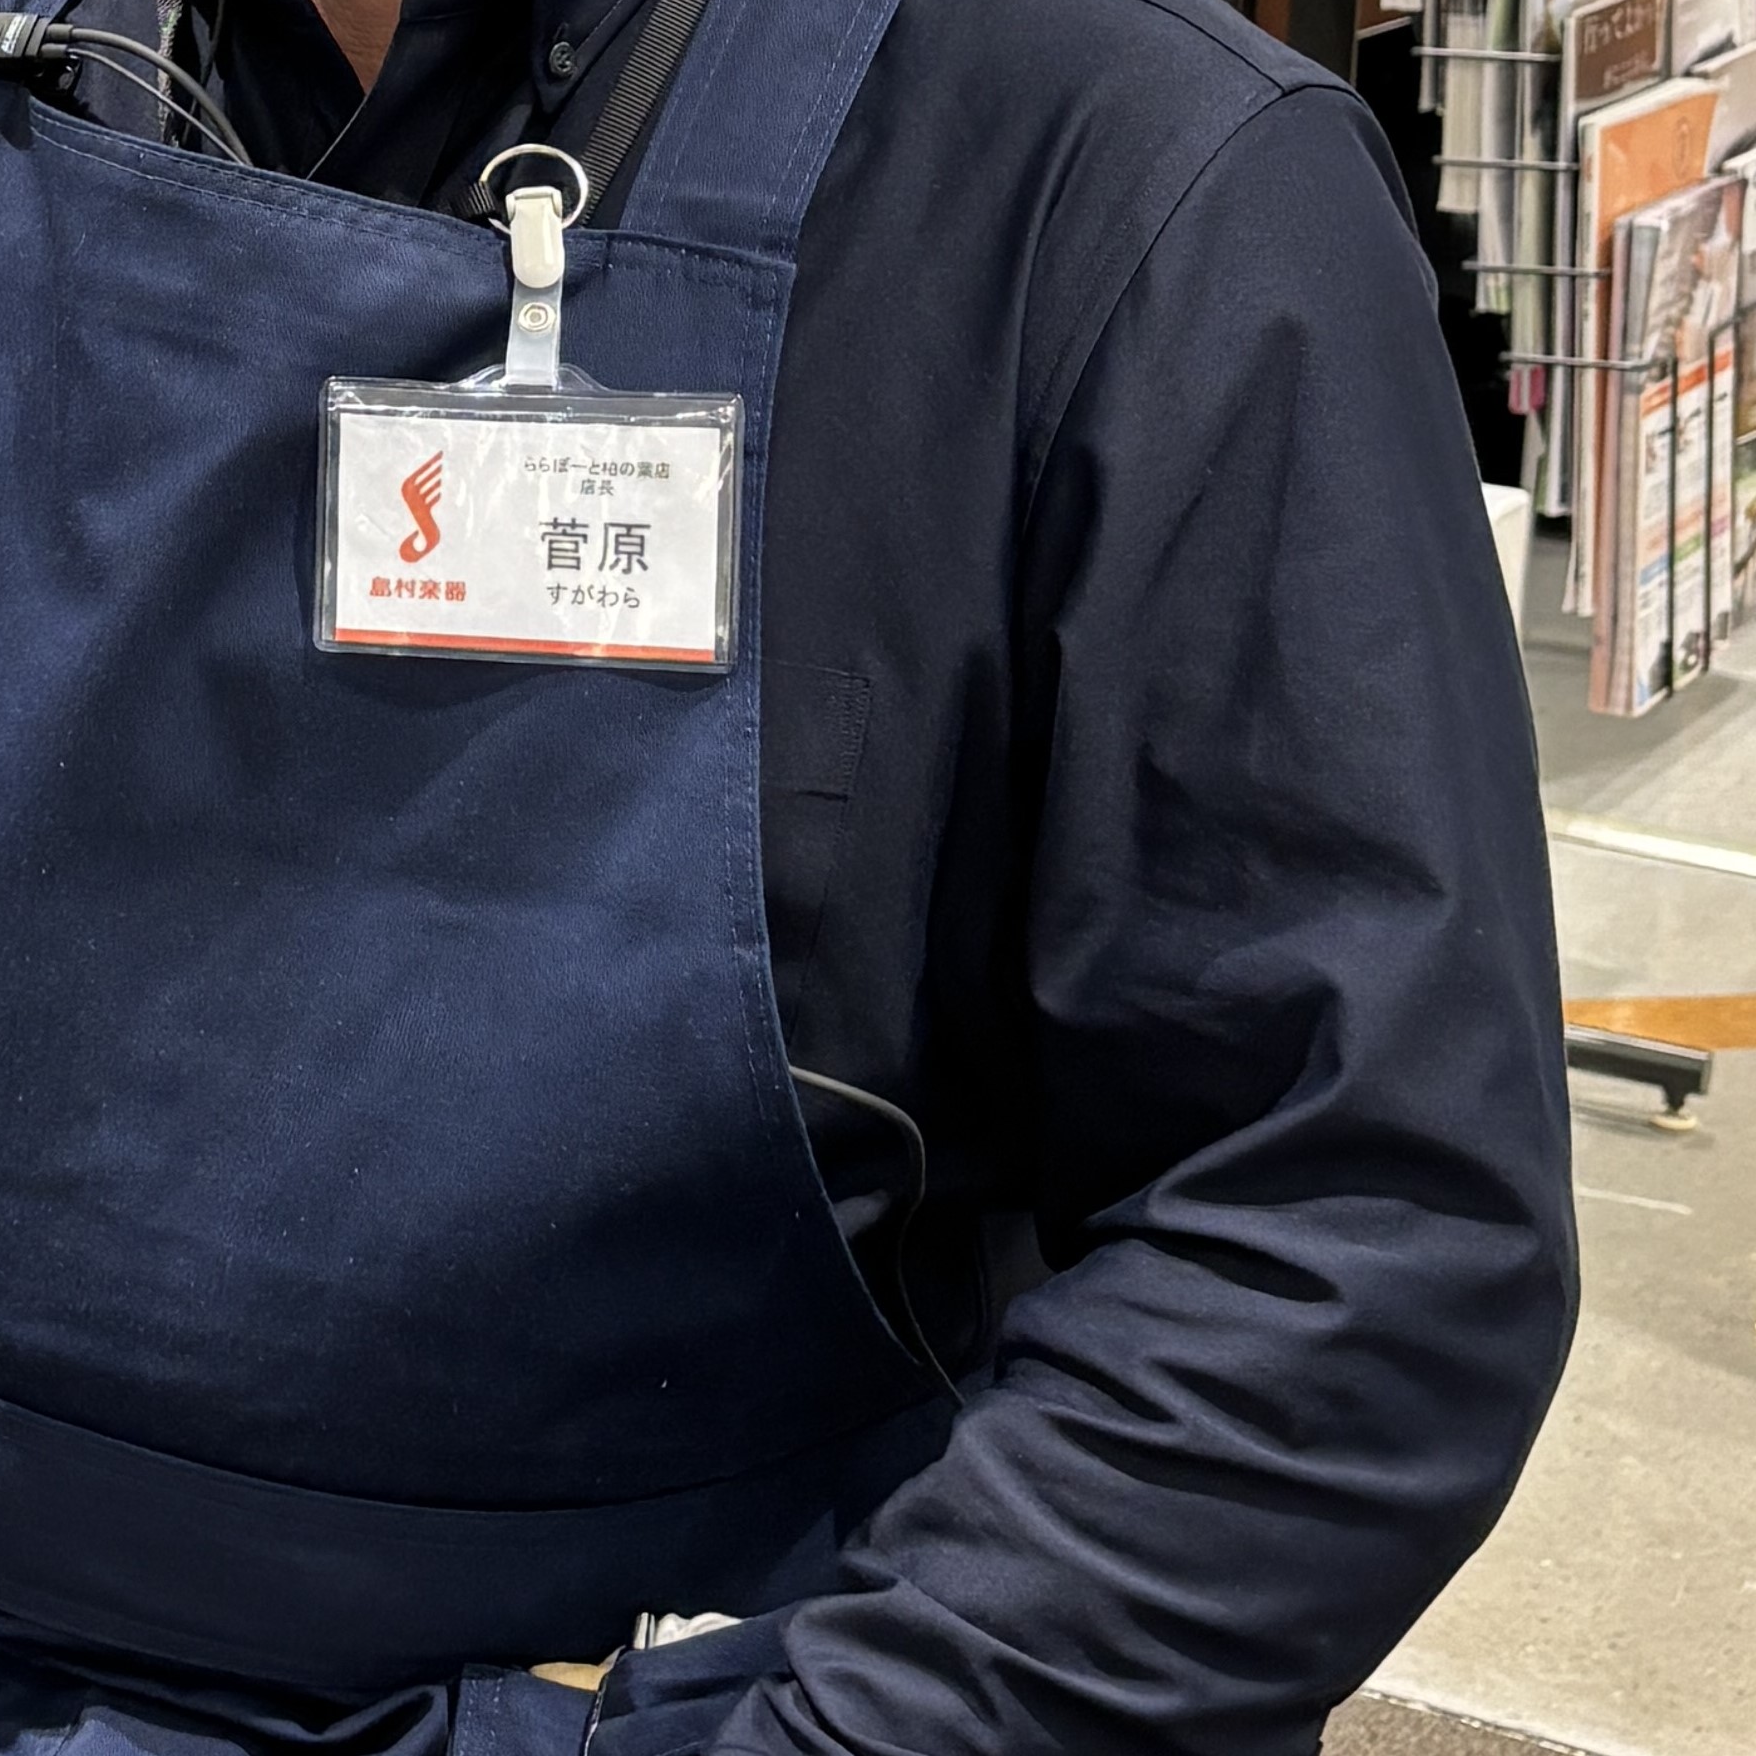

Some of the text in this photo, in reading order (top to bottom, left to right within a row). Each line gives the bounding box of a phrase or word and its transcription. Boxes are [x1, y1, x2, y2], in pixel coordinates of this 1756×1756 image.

[580, 479, 615, 496] 店長
[539, 517, 651, 575] 菅原
[370, 576, 466, 602] 島村楽器
[546, 583, 640, 609] すがわら
